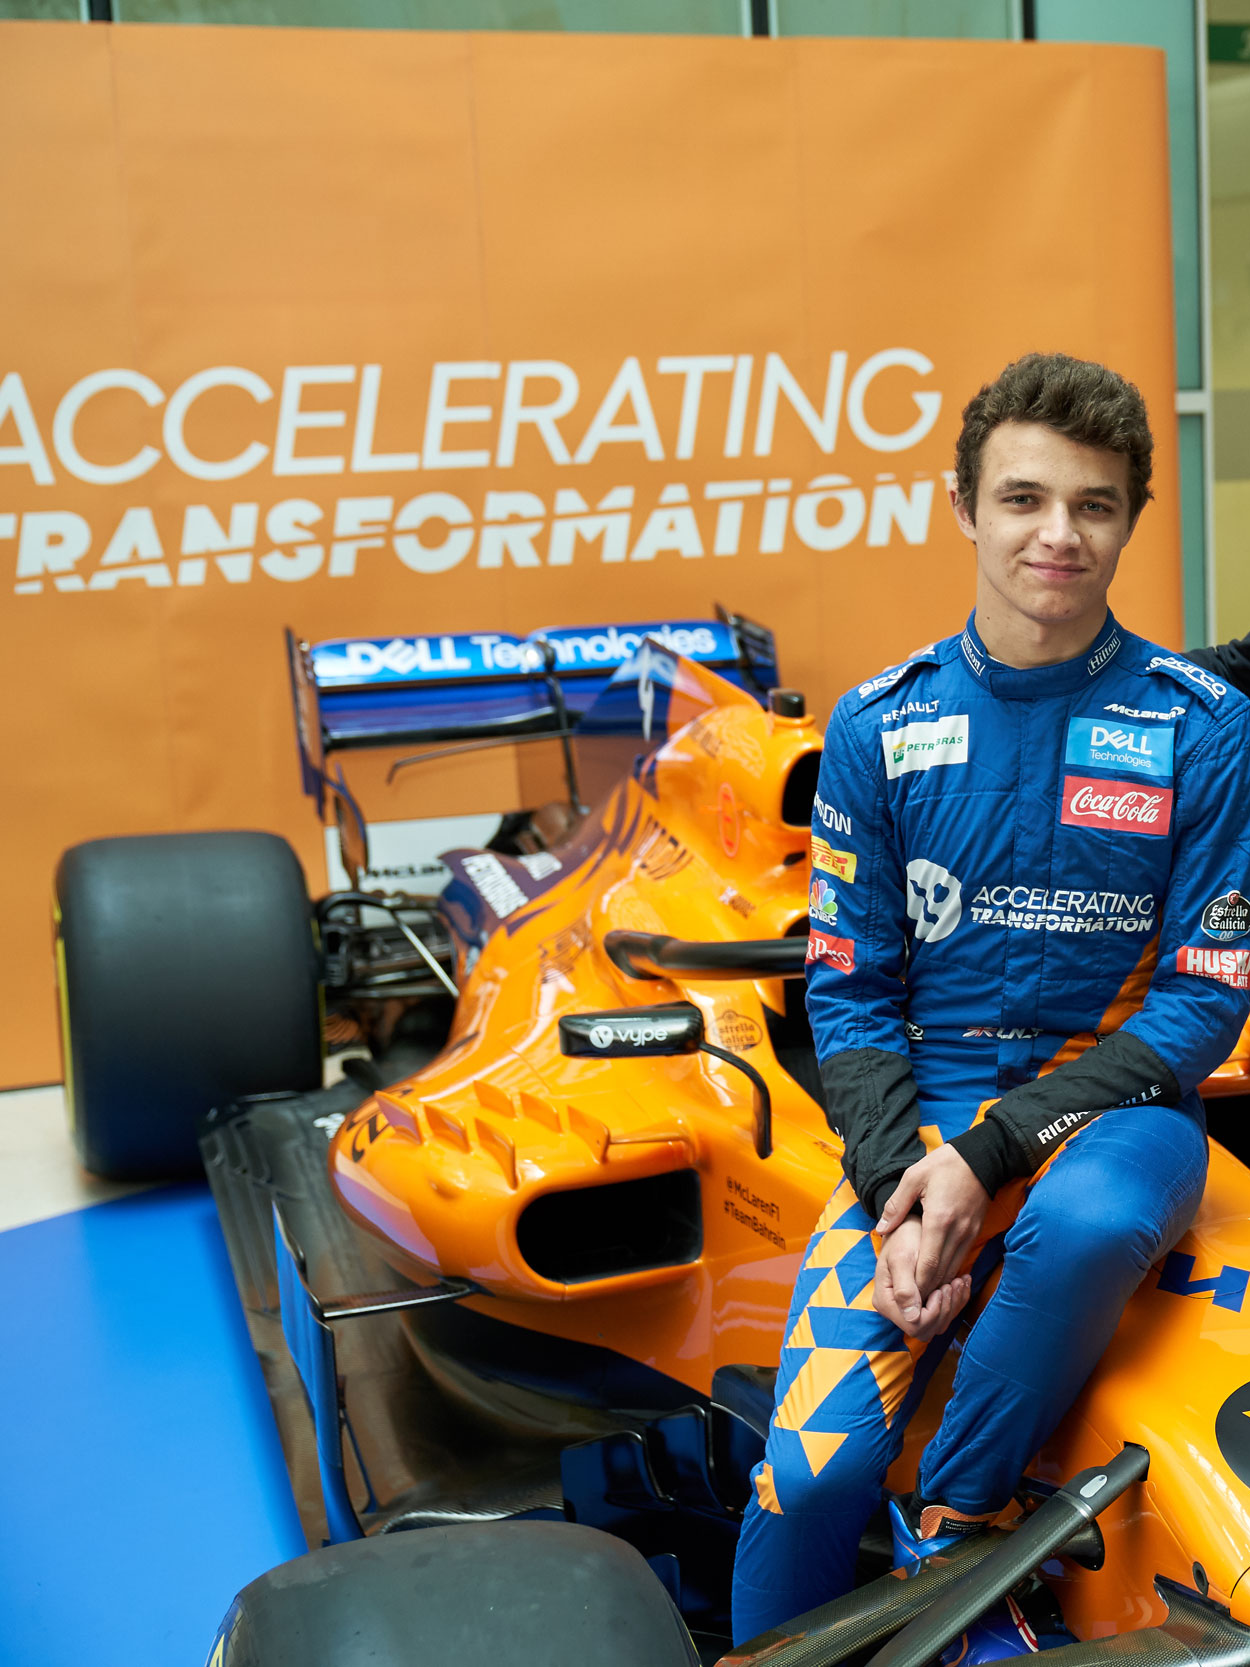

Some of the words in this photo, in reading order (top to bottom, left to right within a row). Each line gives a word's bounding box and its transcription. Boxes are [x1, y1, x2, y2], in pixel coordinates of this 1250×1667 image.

[346, 638, 472, 675] DELL
[1089, 637, 1118, 669] Hilton
[1090, 726, 1152, 755] DELL
[1090, 749, 1151, 768] Technologies
[1070, 786, 1164, 824] Coca-Cola
[972, 885, 1155, 915] ACCELERATING
[1210, 905, 1248, 917] Estrella
[809, 905, 838, 927] CNBC
[1209, 917, 1246, 930] Galicia
[616, 1028, 668, 1047] vype
